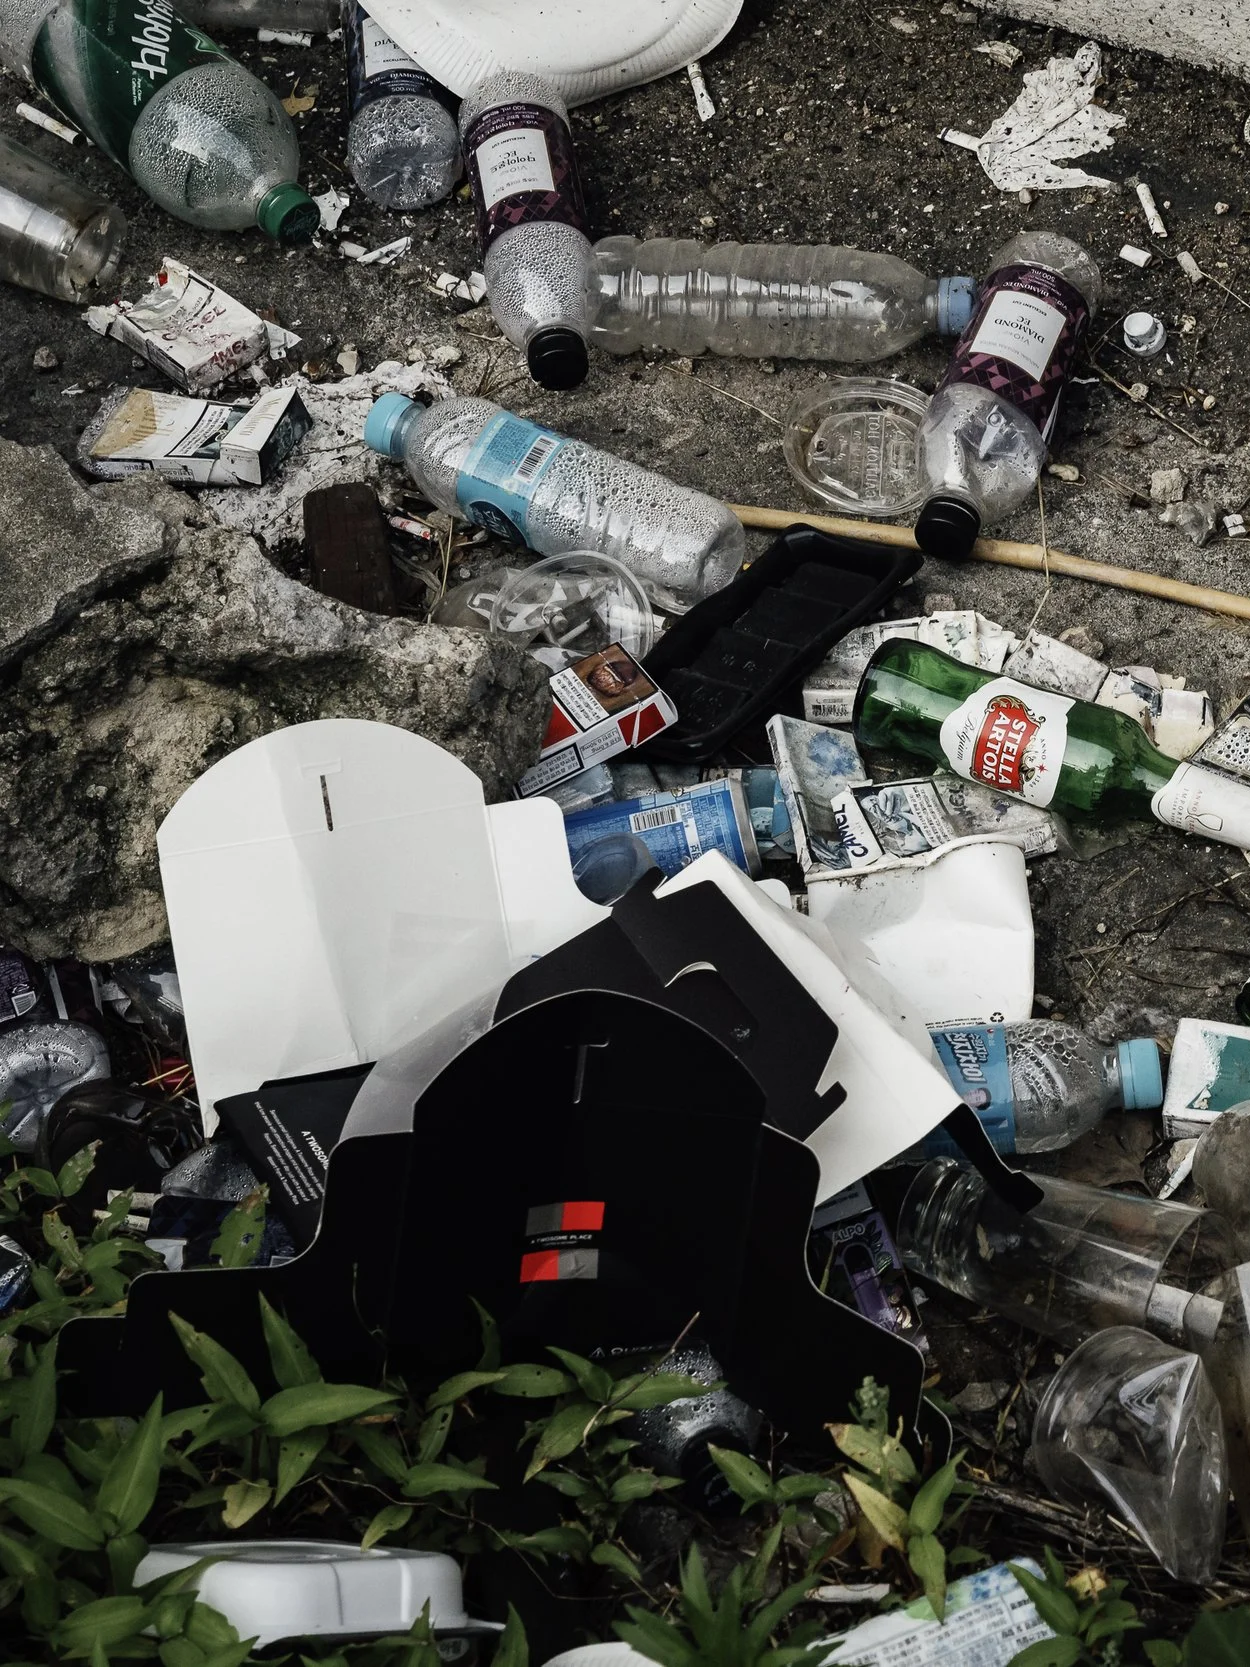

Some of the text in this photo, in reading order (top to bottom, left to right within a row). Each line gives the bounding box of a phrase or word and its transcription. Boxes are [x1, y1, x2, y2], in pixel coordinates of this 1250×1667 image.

[390, 72, 425, 82] DIAMOND
[503, 150, 517, 160] EC
[1042, 272, 1056, 283] 500
[1011, 282, 1050, 298] DIAMOND
[162, 305, 226, 341] CEL
[994, 318, 1046, 344] DIAMOND
[1016, 315, 1031, 326] EC
[957, 710, 979, 762] Belgium
[982, 711, 1011, 782] ARTOIS
[998, 716, 1028, 786] STELLA
[834, 803, 869, 858] CAMEL
[946, 1033, 986, 1083] 천지차이
[301, 1130, 311, 1138] A
[831, 1223, 867, 1246] ALPO
